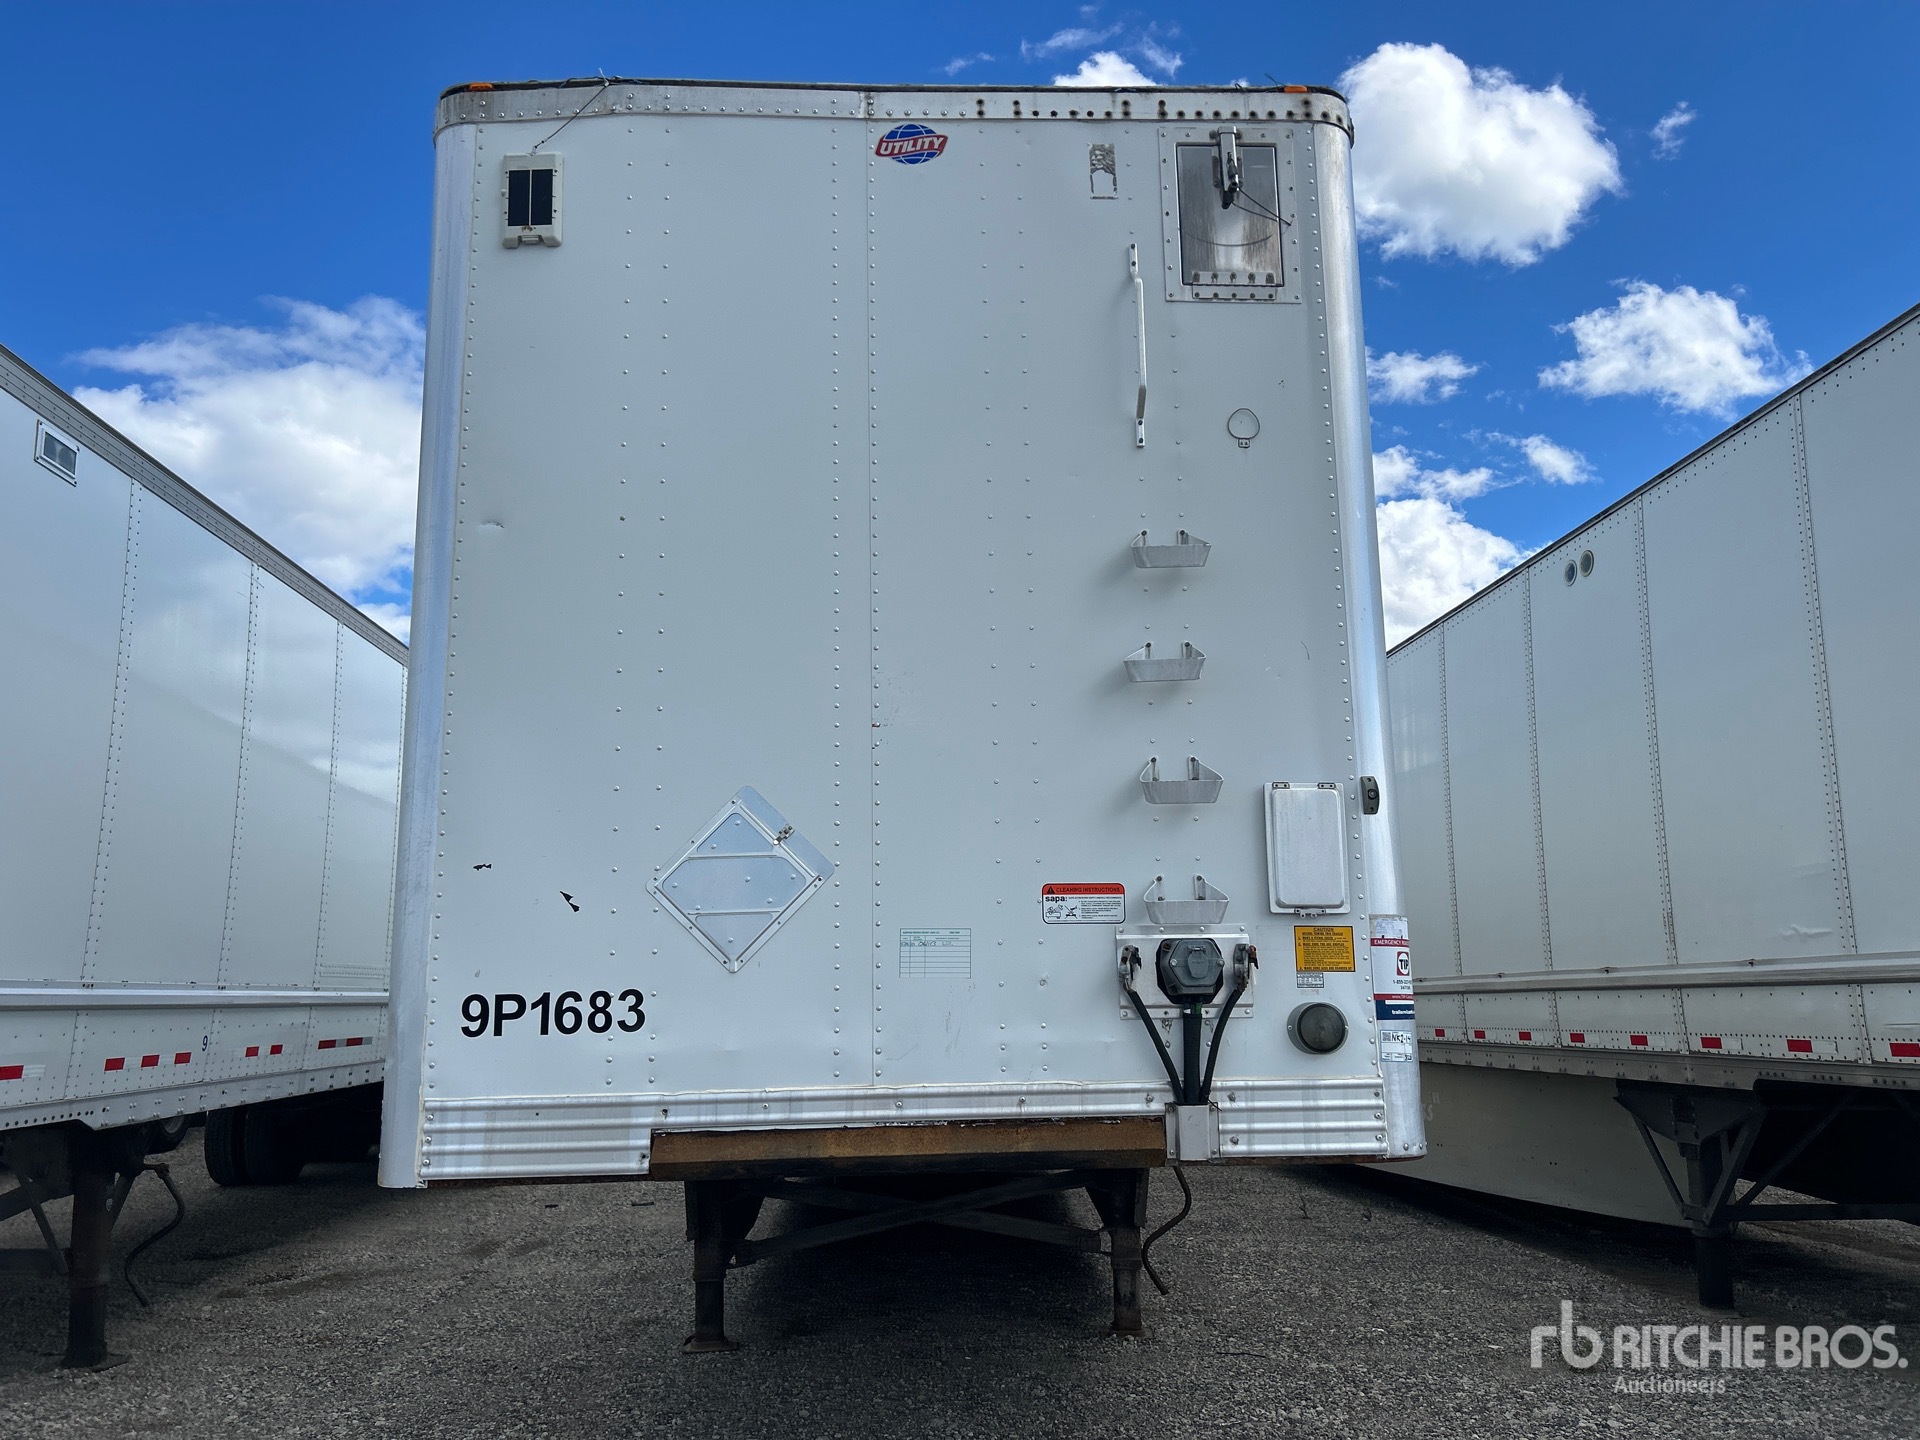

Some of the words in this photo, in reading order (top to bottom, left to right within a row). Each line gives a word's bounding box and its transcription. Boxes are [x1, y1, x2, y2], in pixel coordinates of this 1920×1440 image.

[880, 137, 944, 155] UTILITY
[1399, 959, 1408, 970] TIP
[461, 989, 646, 1038] 9P1683
[202, 1035, 208, 1051] 9
